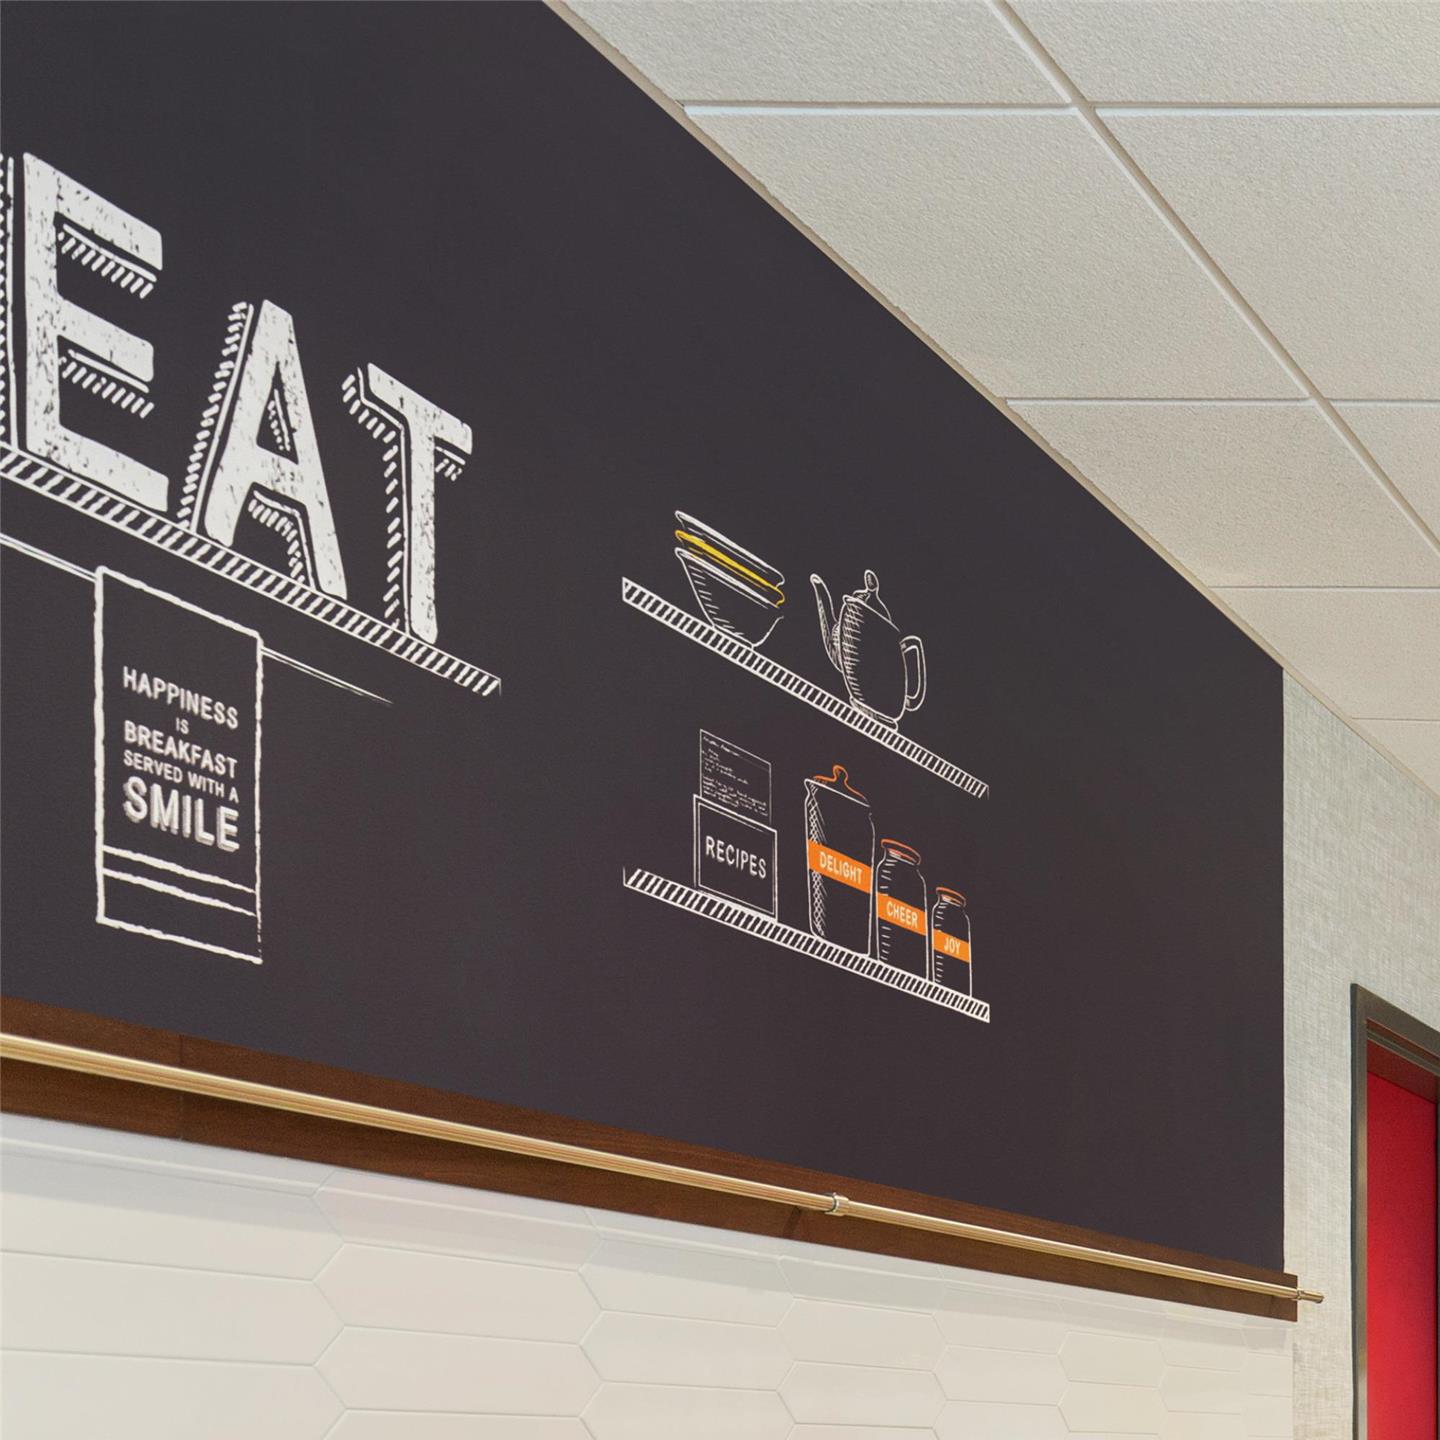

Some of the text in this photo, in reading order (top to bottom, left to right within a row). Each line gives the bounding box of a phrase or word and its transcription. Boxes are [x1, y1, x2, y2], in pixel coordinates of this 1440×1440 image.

[0, 151, 474, 645] EAT
[123, 665, 239, 730] HAPPINESS
[124, 719, 238, 779] BREAKFAST
[175, 716, 190, 735] IS
[123, 749, 239, 804] SERVED WITH A
[123, 775, 240, 853] SMILE
[705, 835, 767, 880] RECIPES
[819, 850, 864, 885] DELIGHT
[886, 900, 919, 929] CHEER
[943, 936, 962, 956] JOY
